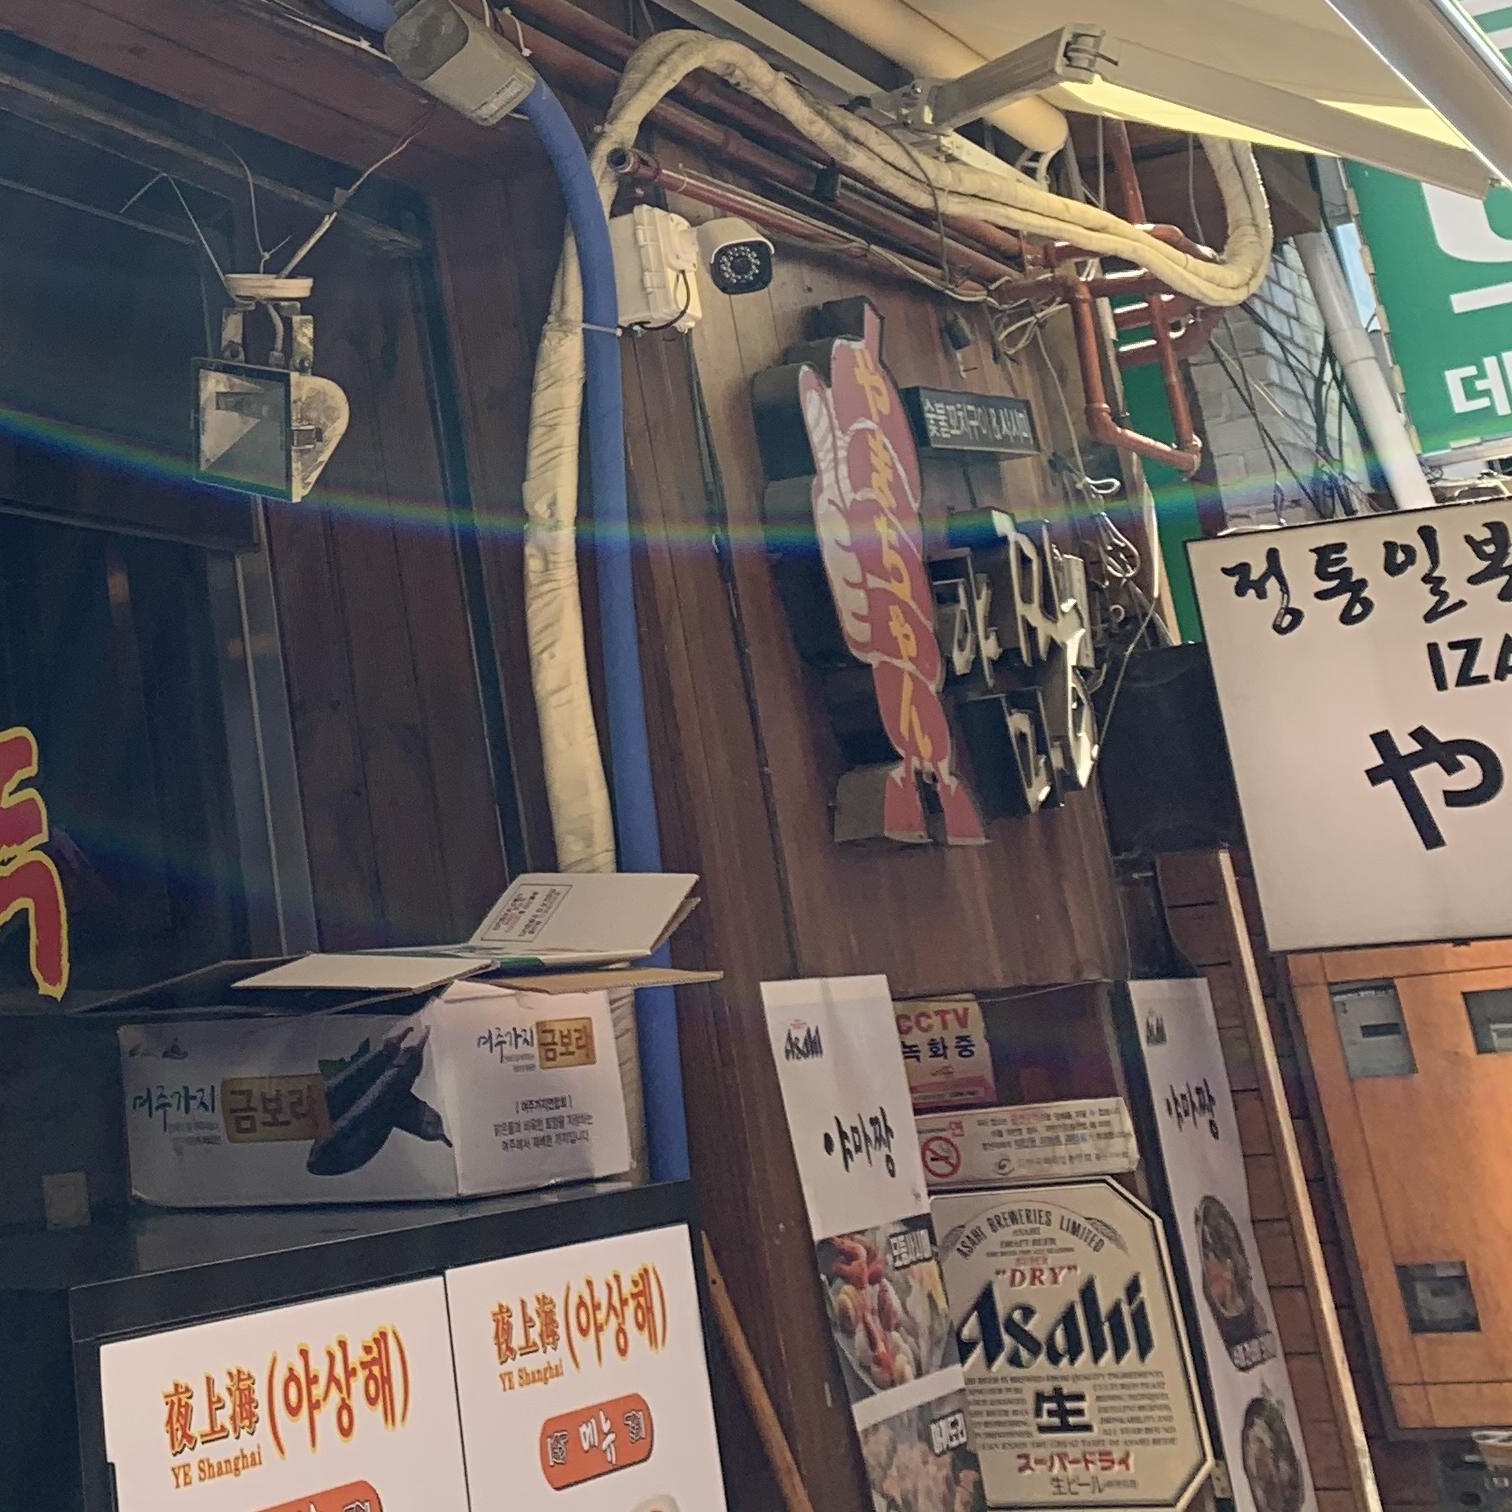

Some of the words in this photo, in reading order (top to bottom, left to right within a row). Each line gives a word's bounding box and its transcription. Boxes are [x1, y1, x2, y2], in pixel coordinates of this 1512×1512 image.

[1365, 725, 1504, 850] や
[896, 1007, 970, 1036] CCTV
[956, 1225, 986, 1260] ASAHI
[986, 1208, 1053, 1234] BREWERIES
[1059, 1215, 1107, 1253] LIMITED
[956, 1271, 1155, 1372] Asahi
[498, 1371, 515, 1392] YE
[518, 1358, 564, 1387] Shanghai
[162, 1366, 259, 1457] 夜上海
[1034, 1386, 1095, 1435] 生
[579, 1408, 617, 1466] 메뉴
[1017, 1450, 1131, 1474] スーパードライ
[171, 1462, 192, 1489] YE
[198, 1444, 263, 1483] Shanghai
